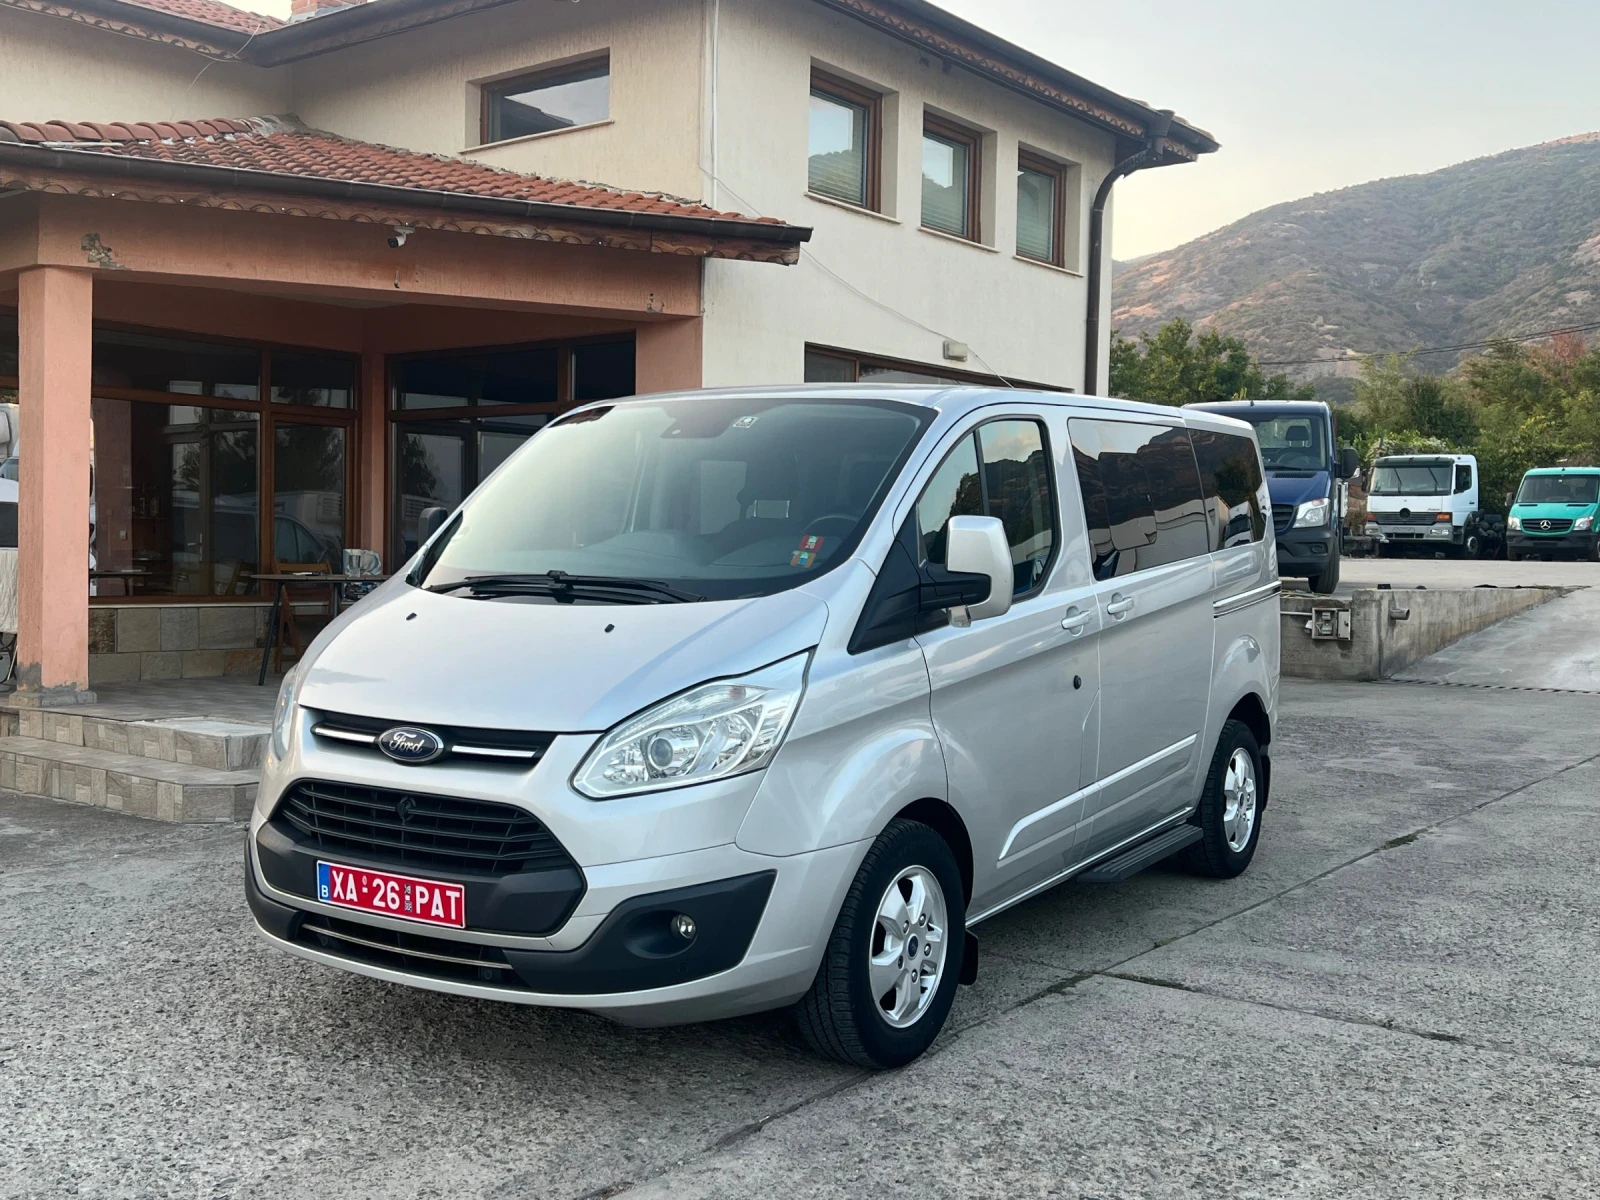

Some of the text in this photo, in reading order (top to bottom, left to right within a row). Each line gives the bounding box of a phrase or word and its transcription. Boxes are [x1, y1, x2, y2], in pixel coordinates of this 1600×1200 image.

[389, 731, 425, 753] Ford
[321, 884, 329, 898] B
[332, 869, 461, 920] XA 26 PAT
